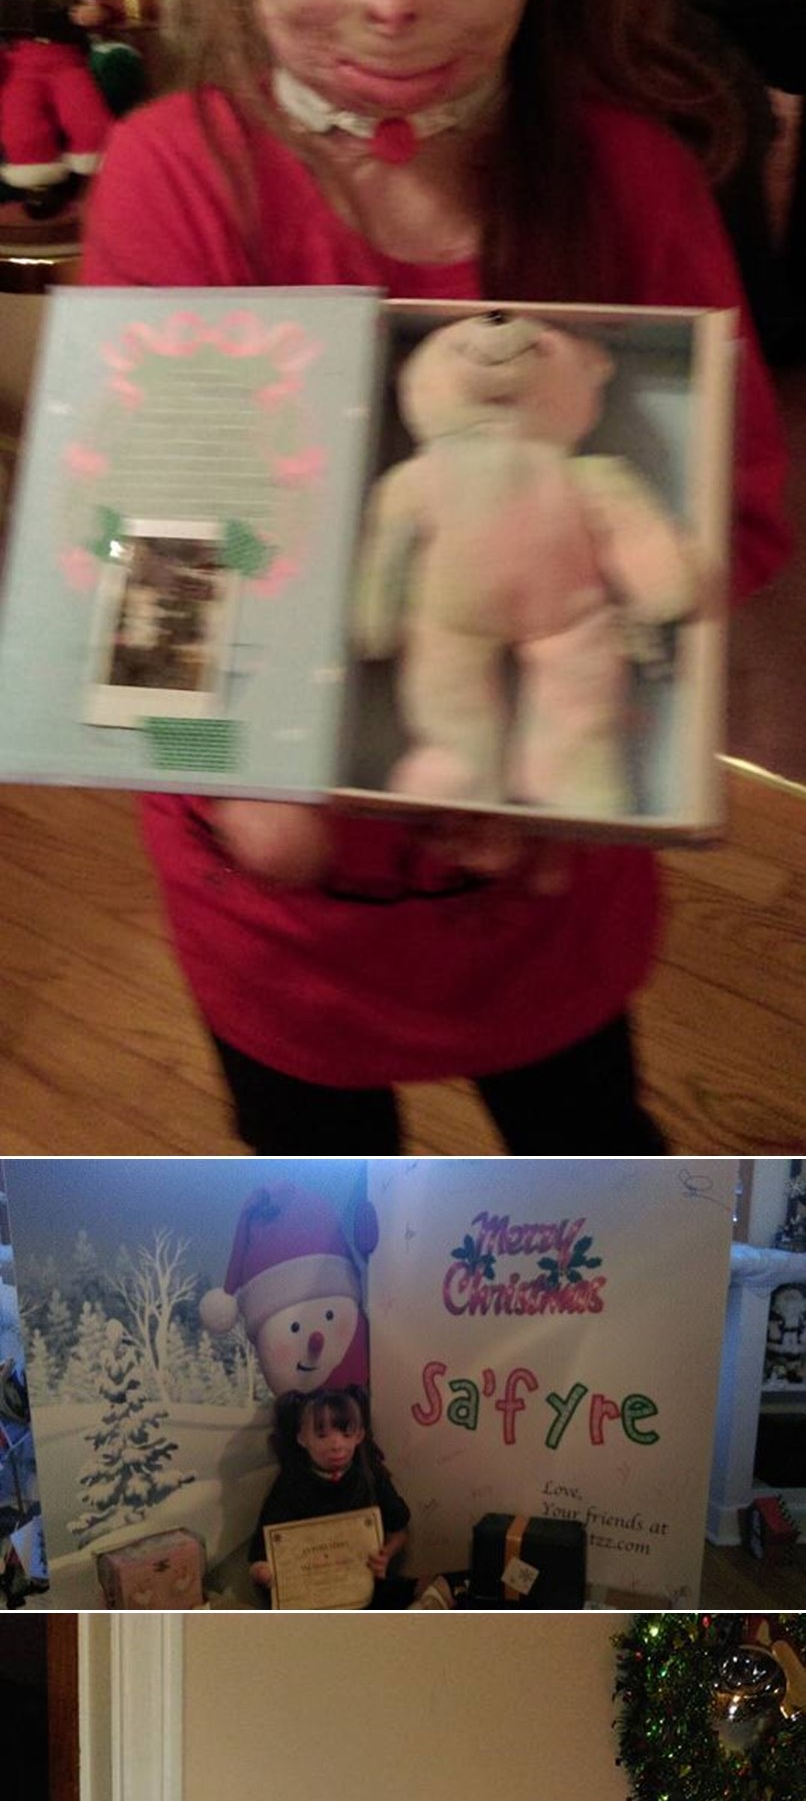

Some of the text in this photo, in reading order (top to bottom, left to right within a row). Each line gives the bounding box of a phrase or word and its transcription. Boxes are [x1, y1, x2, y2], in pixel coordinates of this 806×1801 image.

[471, 1210, 587, 1266] Merry
[442, 1261, 607, 1316] Christmas
[541, 1480, 583, 1500] Love,
[542, 1501, 669, 1536] Your friends at
[589, 1533, 650, 1556] tzz.com
